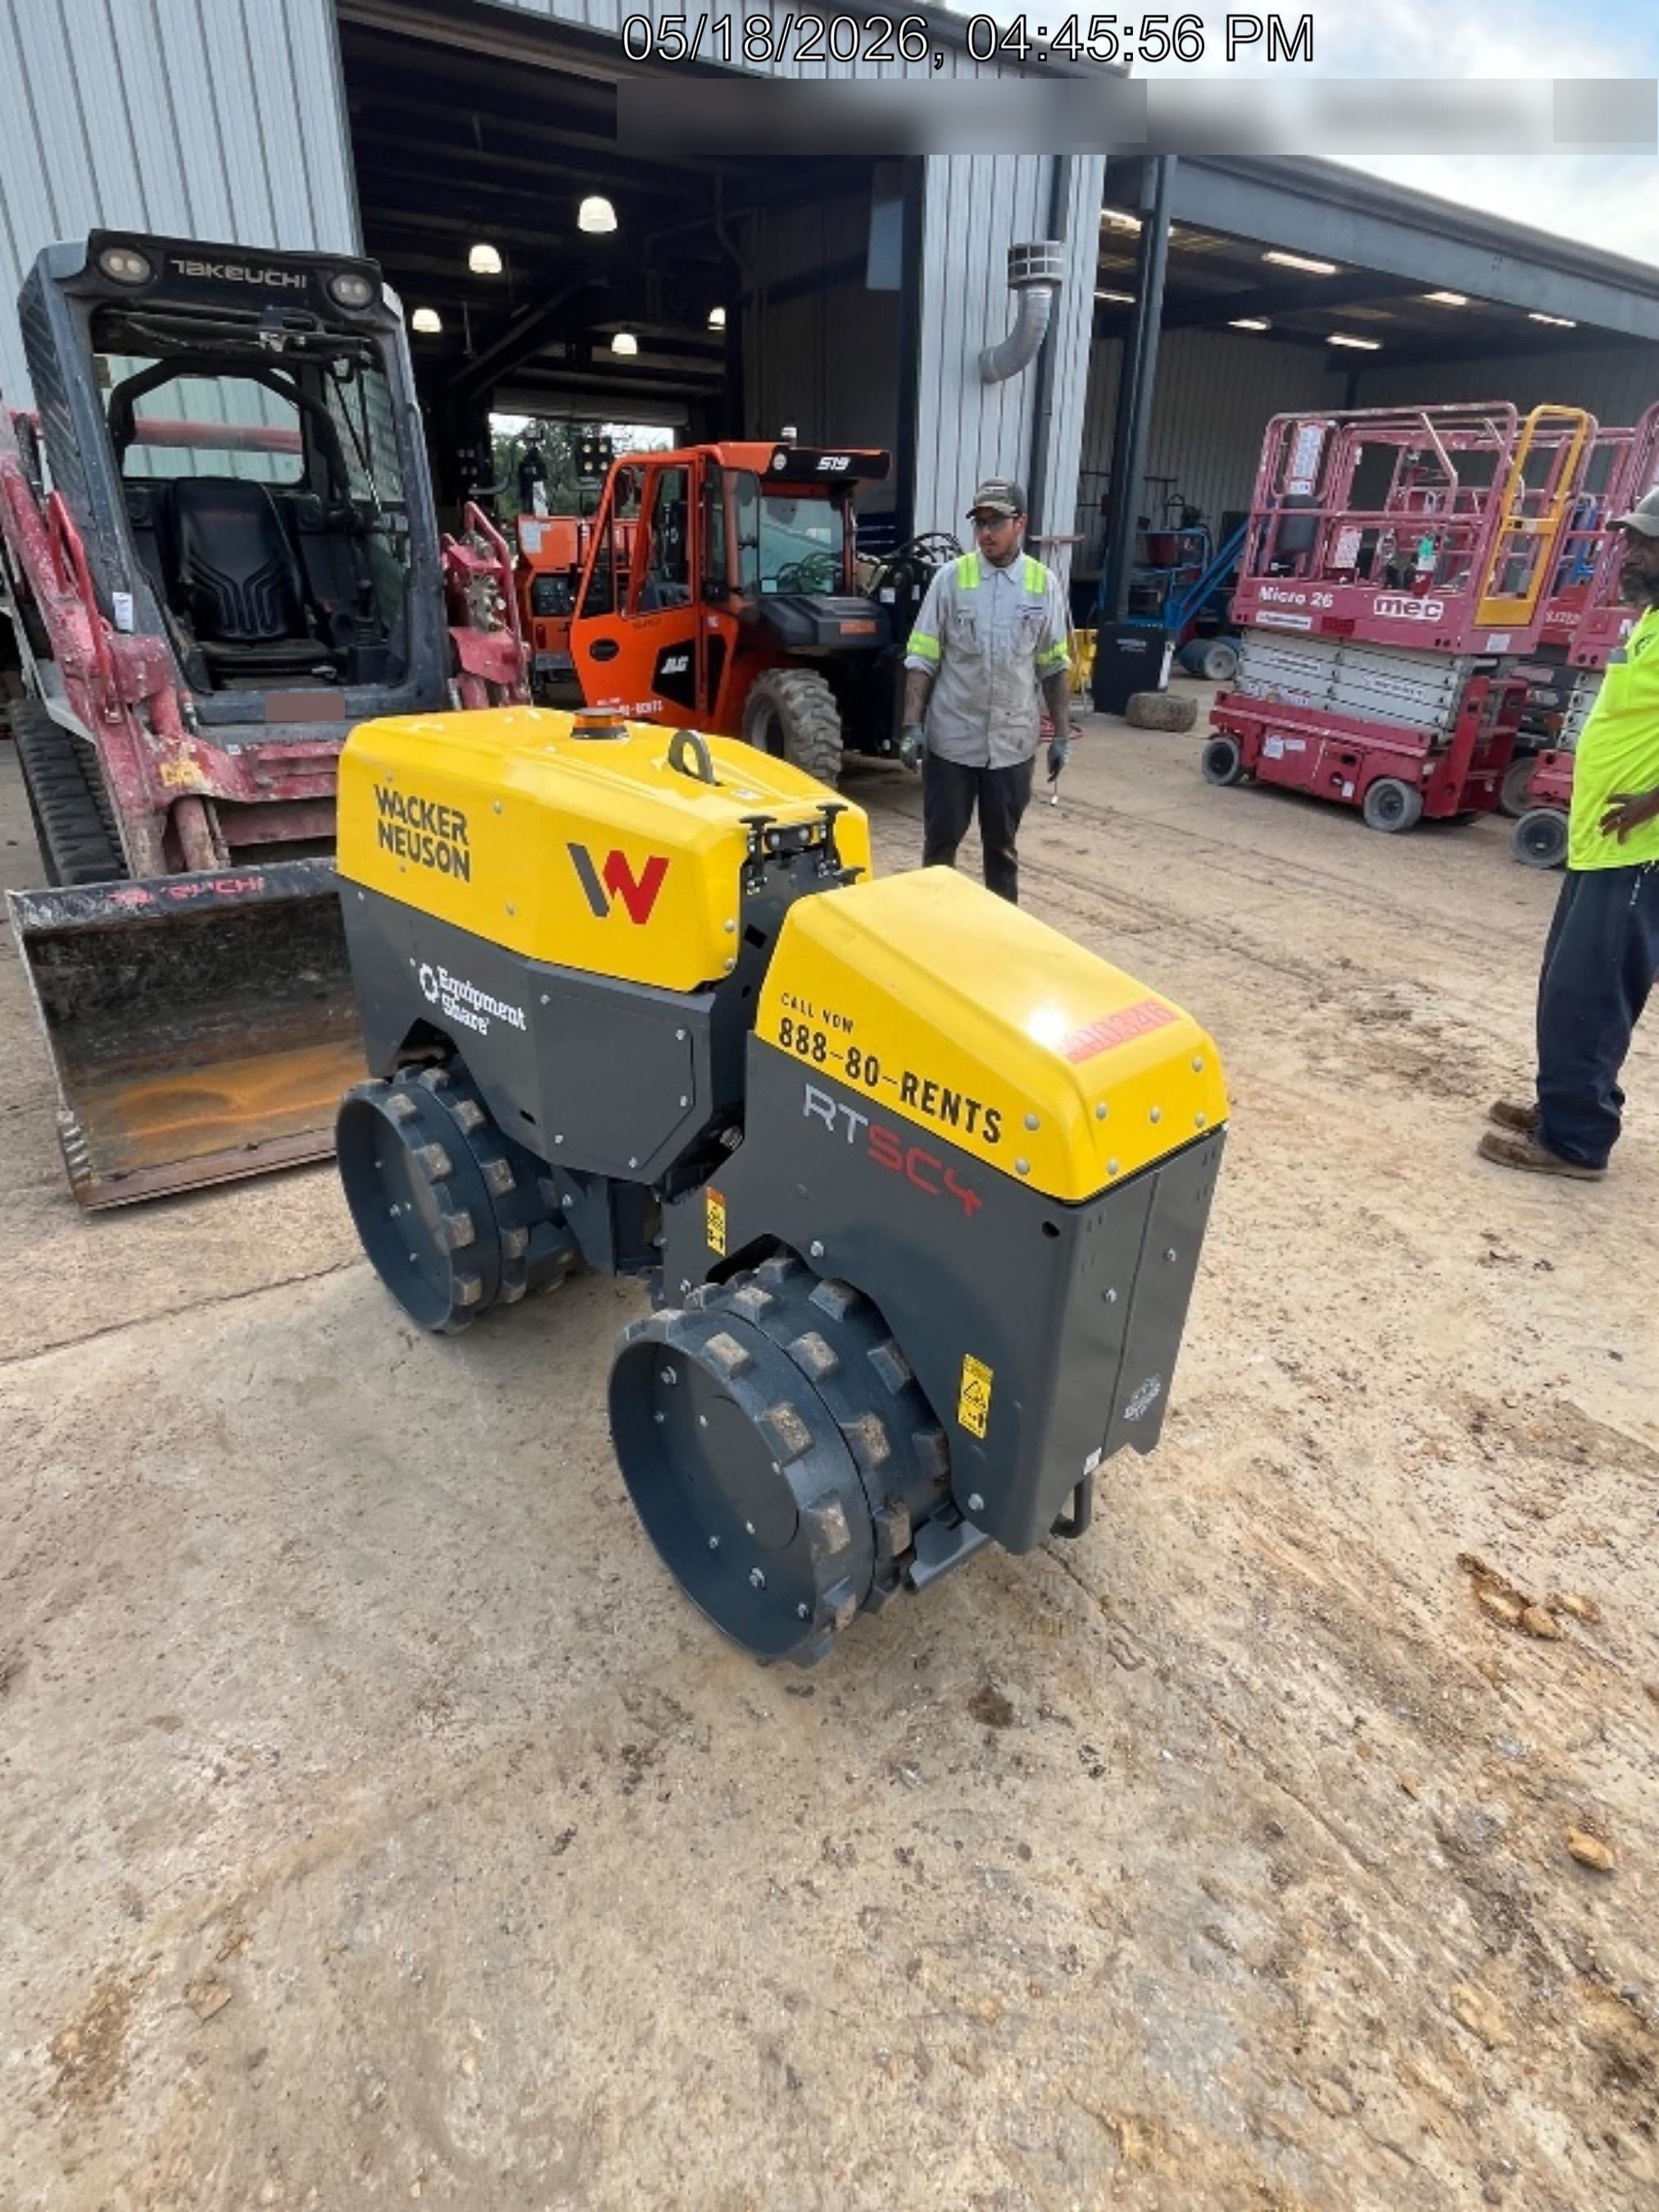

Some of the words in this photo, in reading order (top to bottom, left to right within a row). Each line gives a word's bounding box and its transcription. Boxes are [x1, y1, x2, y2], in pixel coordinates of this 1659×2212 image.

[170, 259, 308, 289] TAKEUCHI
[1258, 587, 1306, 605] Micro
[1310, 592, 1334, 608] 26
[1376, 600, 1442, 618] mec
[373, 783, 470, 846] WACKER
[378, 818, 471, 883] NEUSON
[437, 965, 527, 1031] Equipment
[441, 992, 489, 1036] Share
[781, 992, 814, 1018] CALL
[823, 1009, 854, 1034] NOW
[778, 1017, 1002, 1144] 888-80-RENTS
